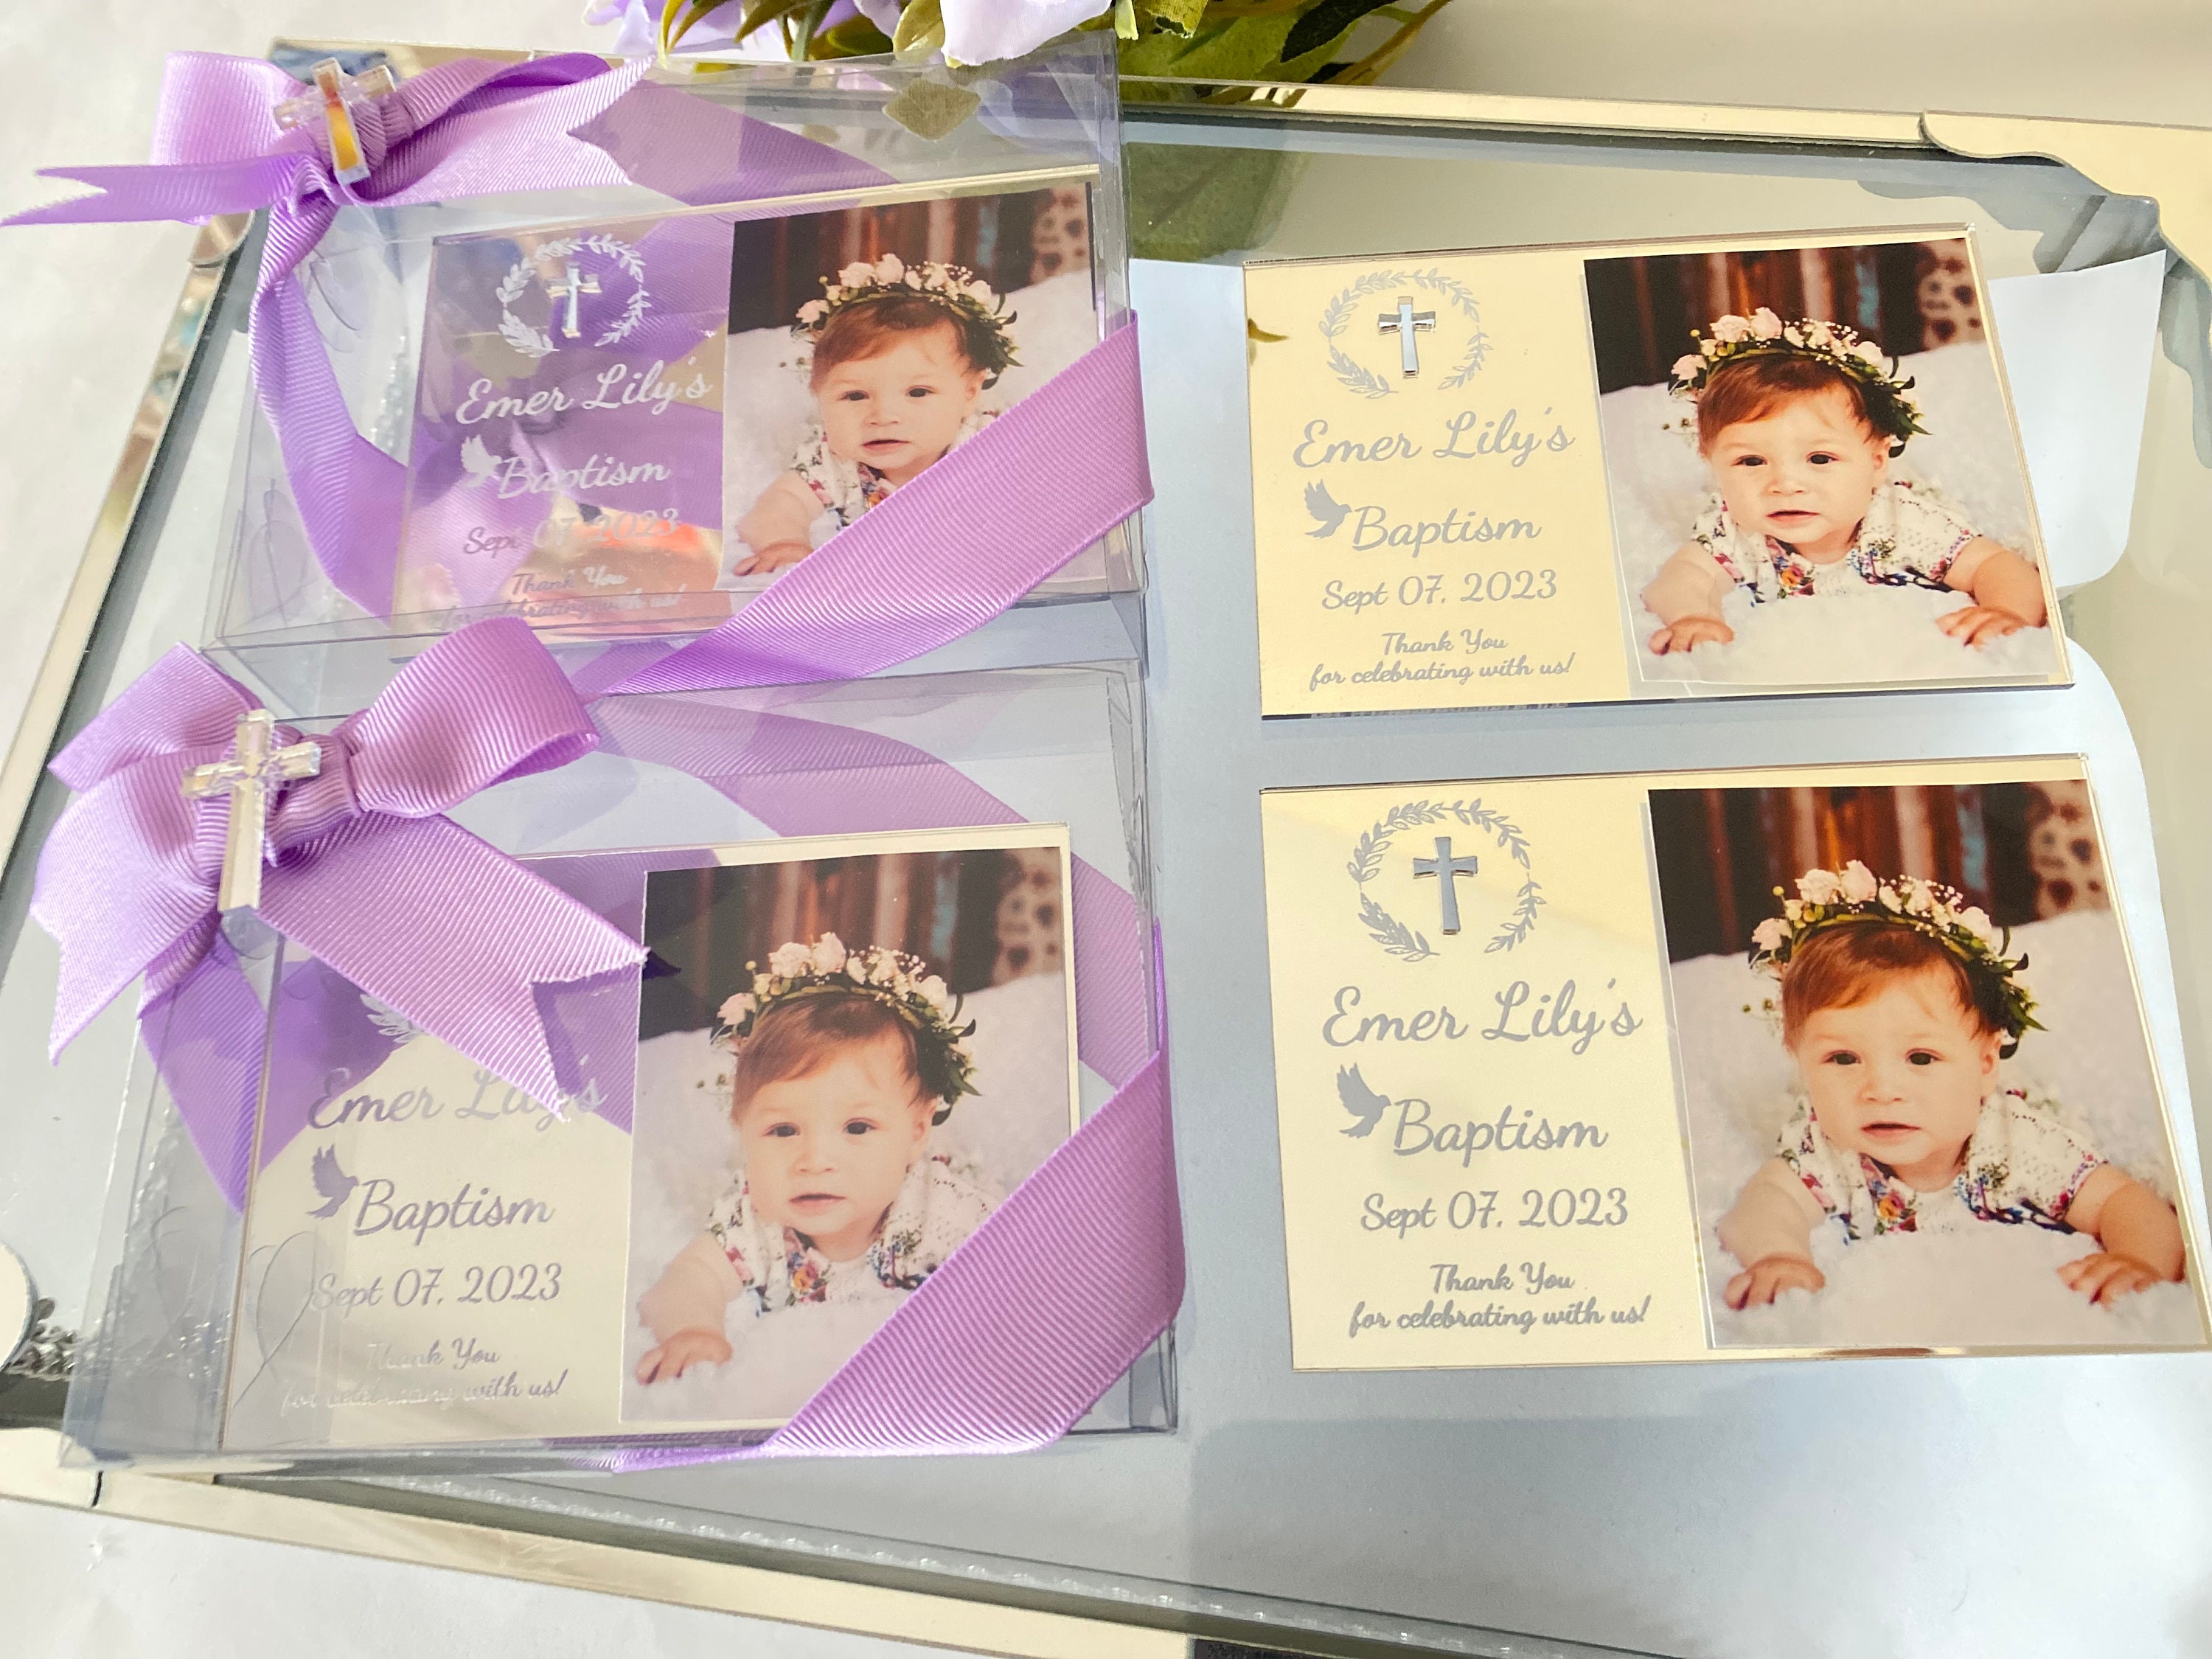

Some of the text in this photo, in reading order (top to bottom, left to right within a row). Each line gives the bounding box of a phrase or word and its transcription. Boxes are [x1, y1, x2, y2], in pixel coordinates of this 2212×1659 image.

[455, 356, 714, 424] Emer Lily's
[1293, 406, 1576, 469] Emer Lily's
[497, 453, 671, 500] Baptism
[589, 508, 679, 543] 2023
[1351, 505, 1543, 558] Baptism
[512, 568, 575, 595] Thank
[1321, 569, 1557, 614] Sept 07. 2023
[1381, 628, 1509, 656] Thank You
[1309, 653, 1576, 692] for celebrating with us!
[1322, 978, 1644, 1055] Emer Lily's
[307, 1067, 445, 1130] Emer
[1393, 1098, 1609, 1168] Baptism
[354, 1179, 555, 1245] Baptism
[1360, 1186, 1628, 1239] Sept 07. 2023
[310, 1262, 563, 1318] Sept 07. 2023
[1430, 1262, 1575, 1293] Thank You
[1349, 1293, 1652, 1337] for celebrating with us!
[367, 1336, 500, 1371] Thank You
[465, 1370, 521, 1400] with
[529, 1368, 569, 1397] us!
